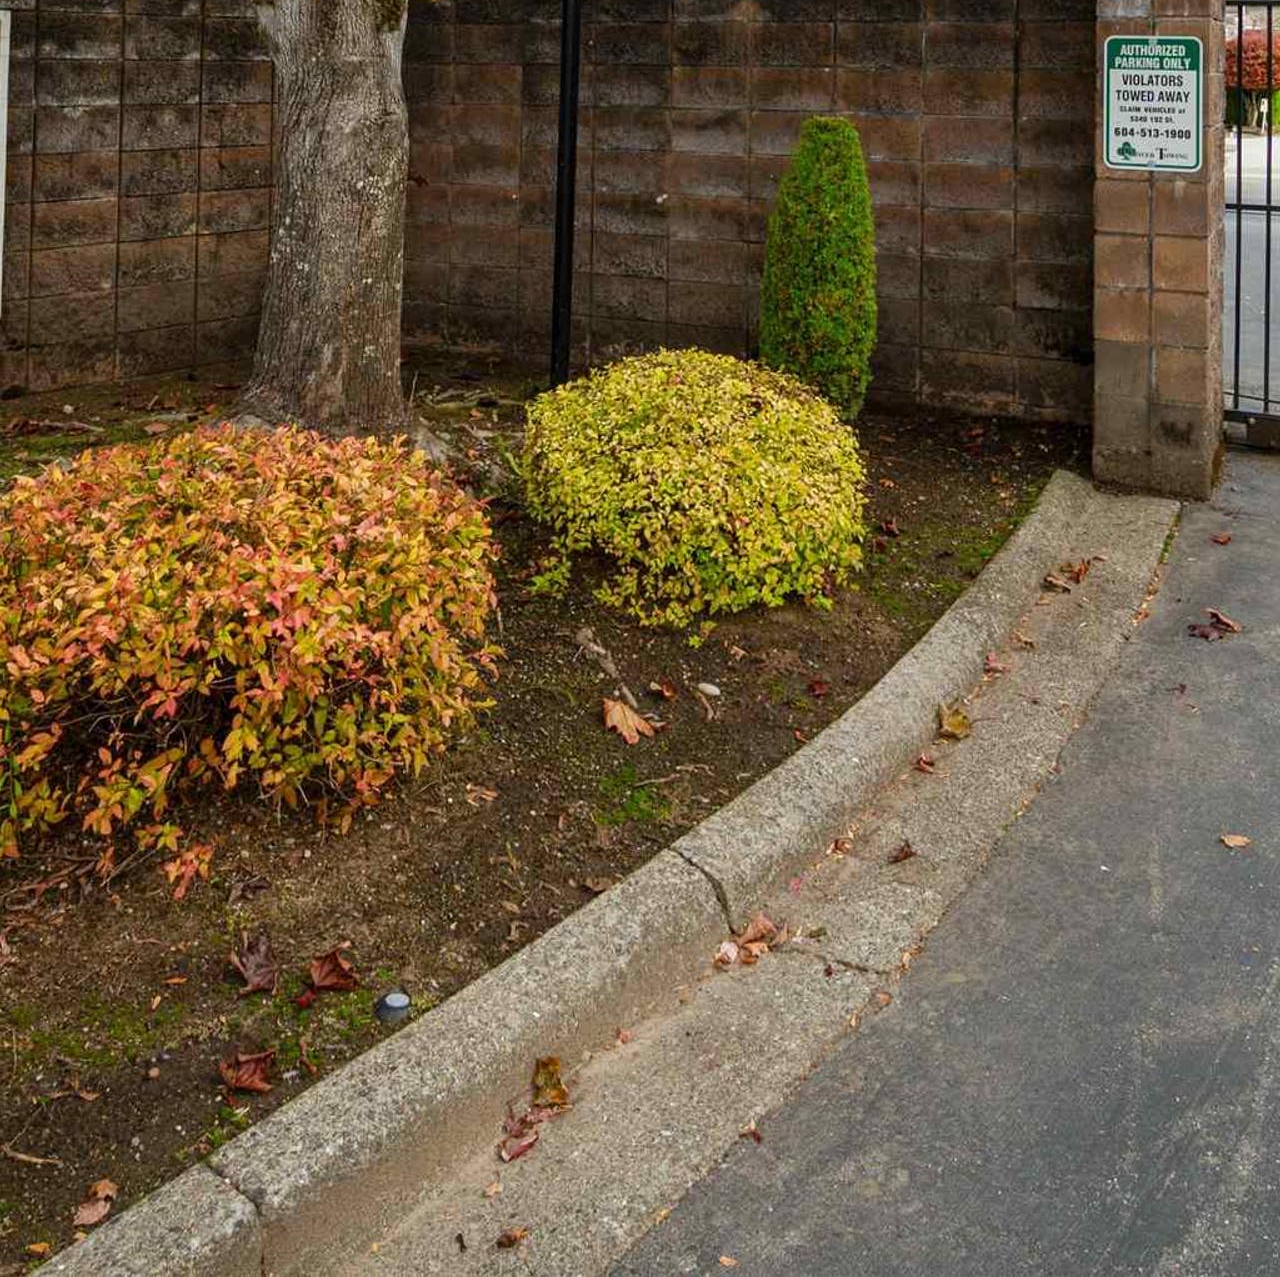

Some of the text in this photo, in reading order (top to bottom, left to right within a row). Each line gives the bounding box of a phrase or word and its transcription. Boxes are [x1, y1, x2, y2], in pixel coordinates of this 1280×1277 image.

[1120, 44, 1186, 56] AUTHORIZED
[1114, 56, 1191, 69] PARKING ONLY
[1122, 74, 1184, 87] VIOLATORS
[1116, 89, 1190, 103] TOWED AWAY
[1114, 127, 1191, 139] 604-513-1900
